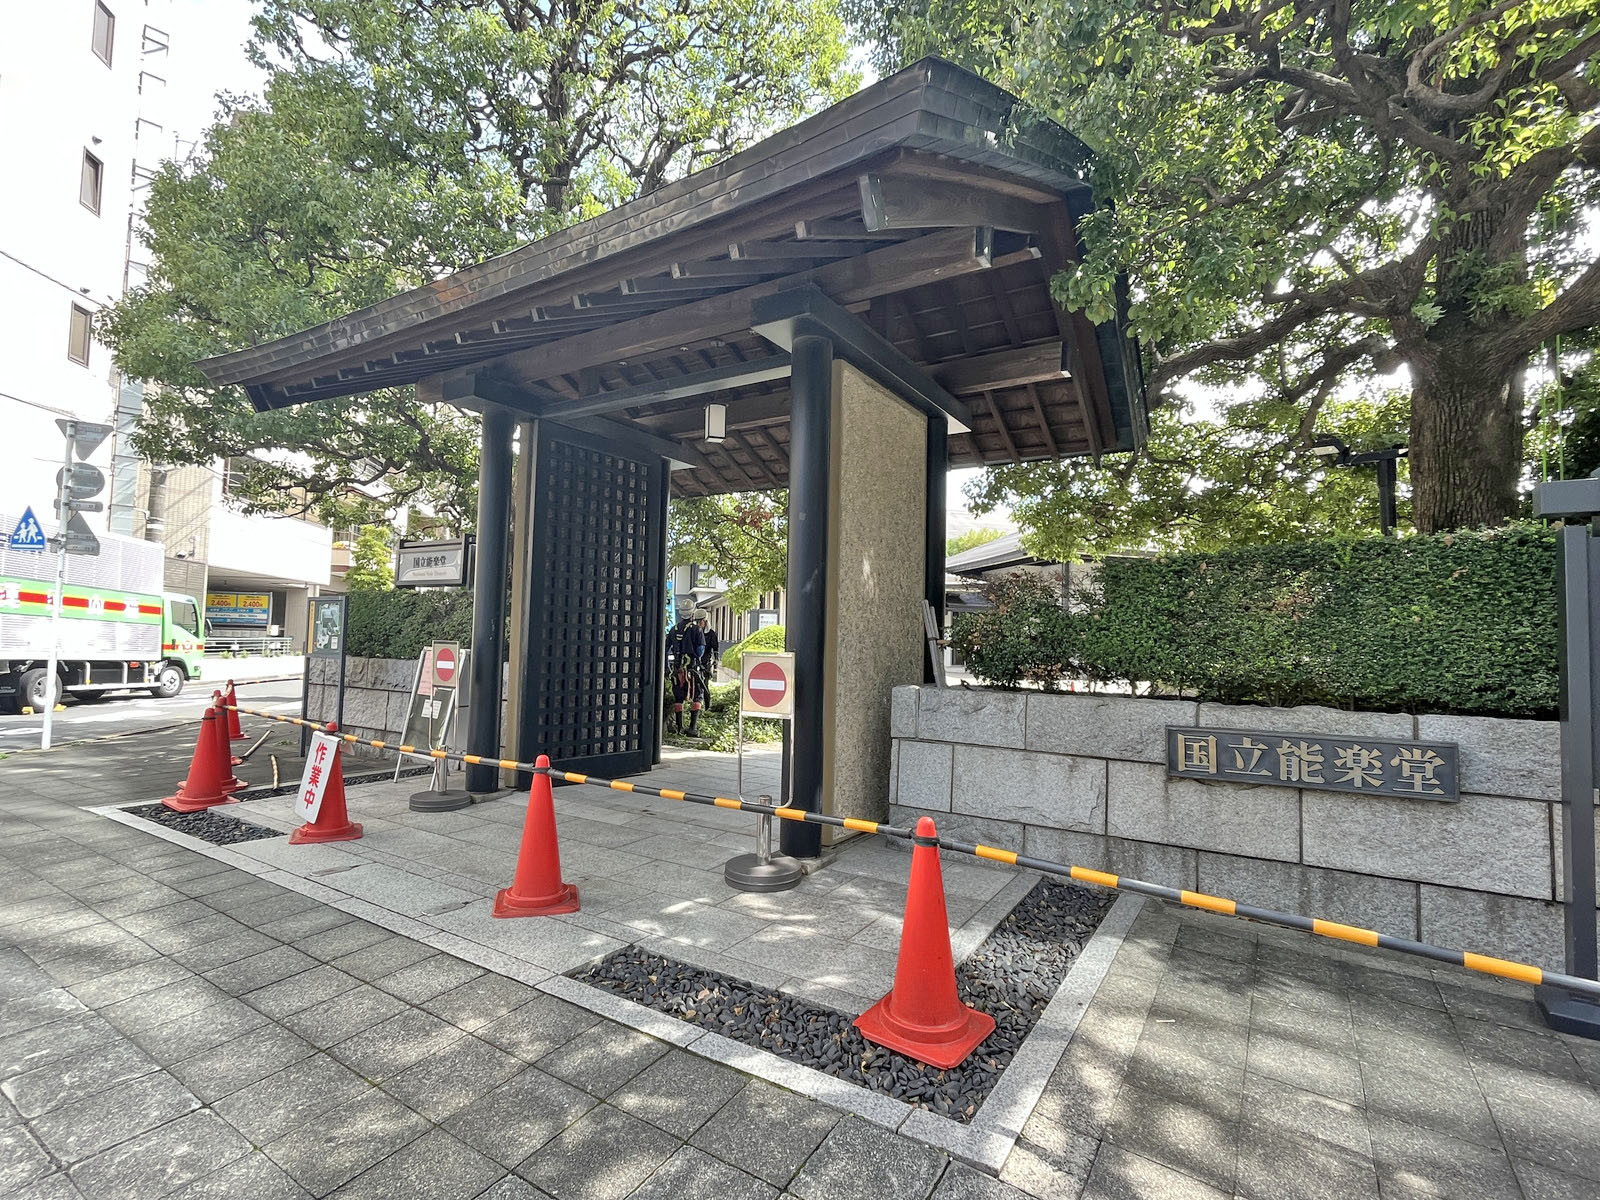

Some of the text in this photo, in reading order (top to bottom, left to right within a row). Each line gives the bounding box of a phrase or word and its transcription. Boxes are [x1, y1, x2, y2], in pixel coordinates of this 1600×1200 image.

[304, 742, 327, 809] 作業中
[1177, 733, 1445, 795] 国立能楽堂
